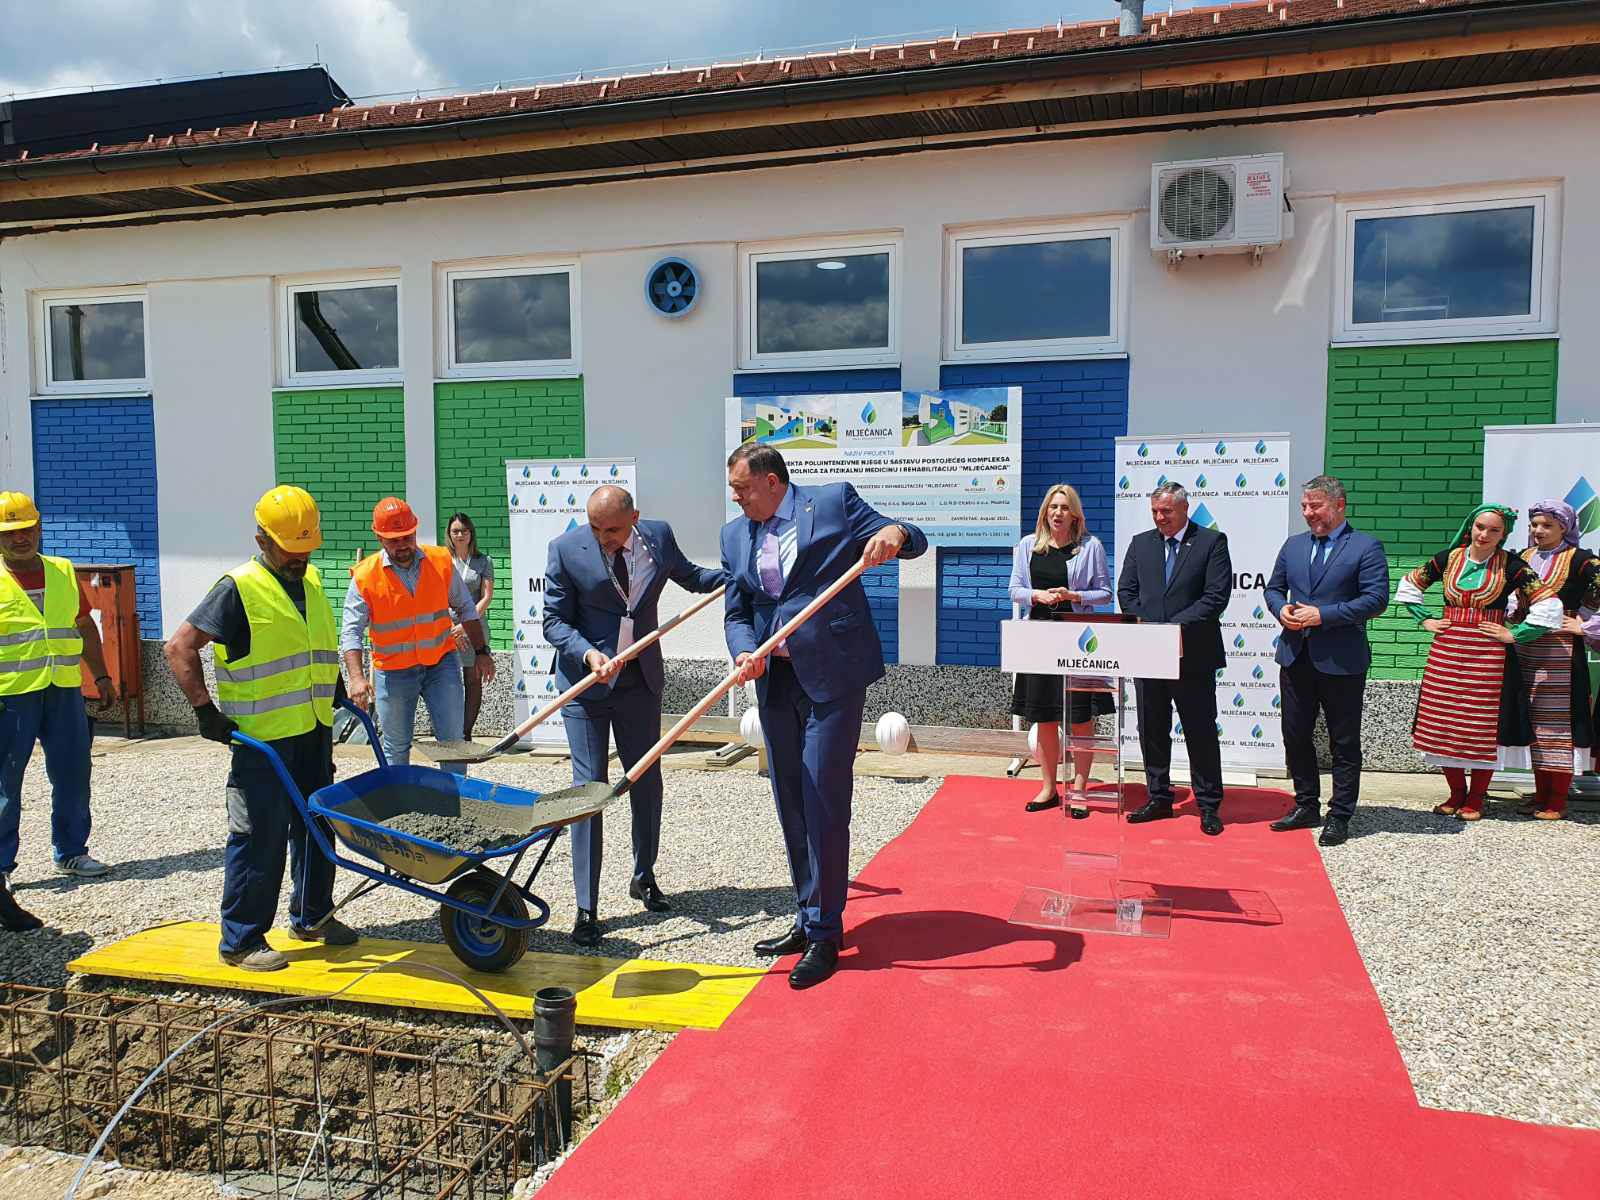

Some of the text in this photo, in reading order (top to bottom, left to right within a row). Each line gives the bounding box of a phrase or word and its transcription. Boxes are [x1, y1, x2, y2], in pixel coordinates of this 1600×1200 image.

[846, 428, 892, 437] MLJEČANICA
[1233, 573, 1266, 590] ICA
[1057, 658, 1120, 669] MLJEČANICA
